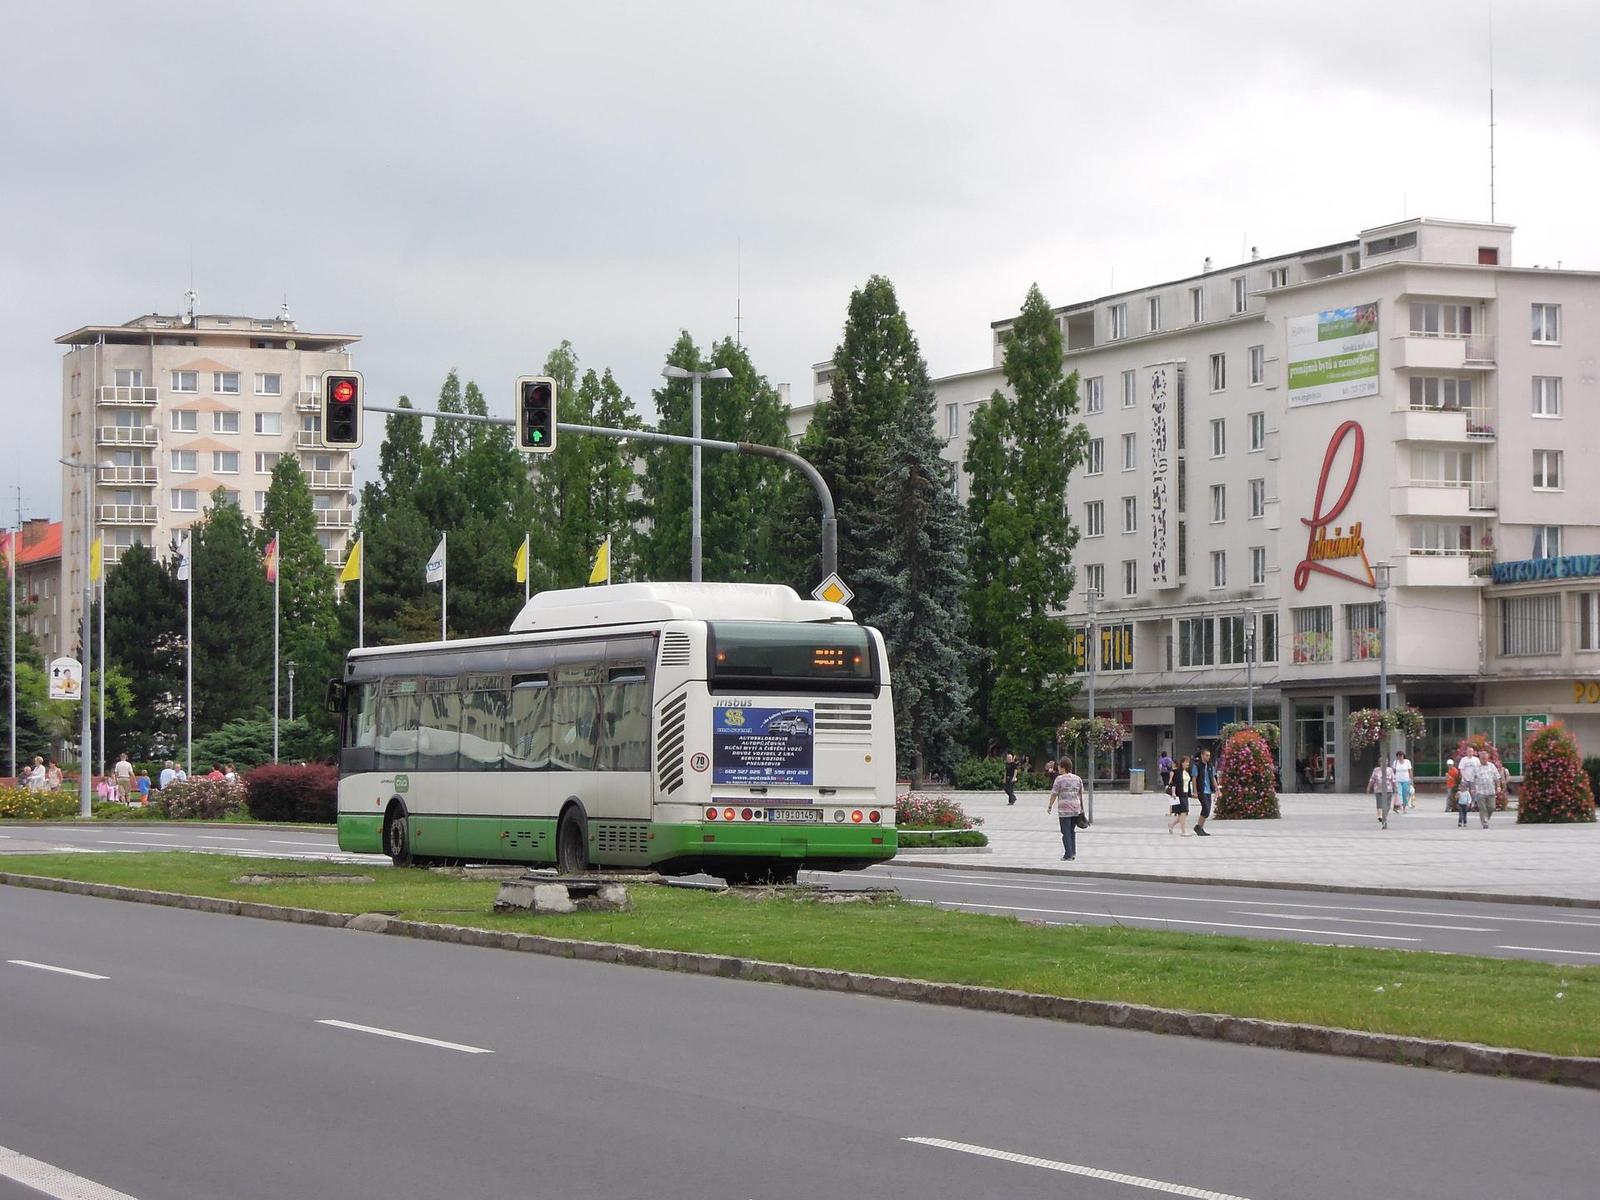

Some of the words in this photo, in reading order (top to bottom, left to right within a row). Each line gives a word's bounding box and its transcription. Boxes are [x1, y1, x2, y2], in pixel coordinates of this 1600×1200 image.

[716, 698, 753, 707] irisbus
[696, 756, 705, 765] 70
[775, 810, 790, 819] 3T9
[795, 810, 814, 820] 0145
